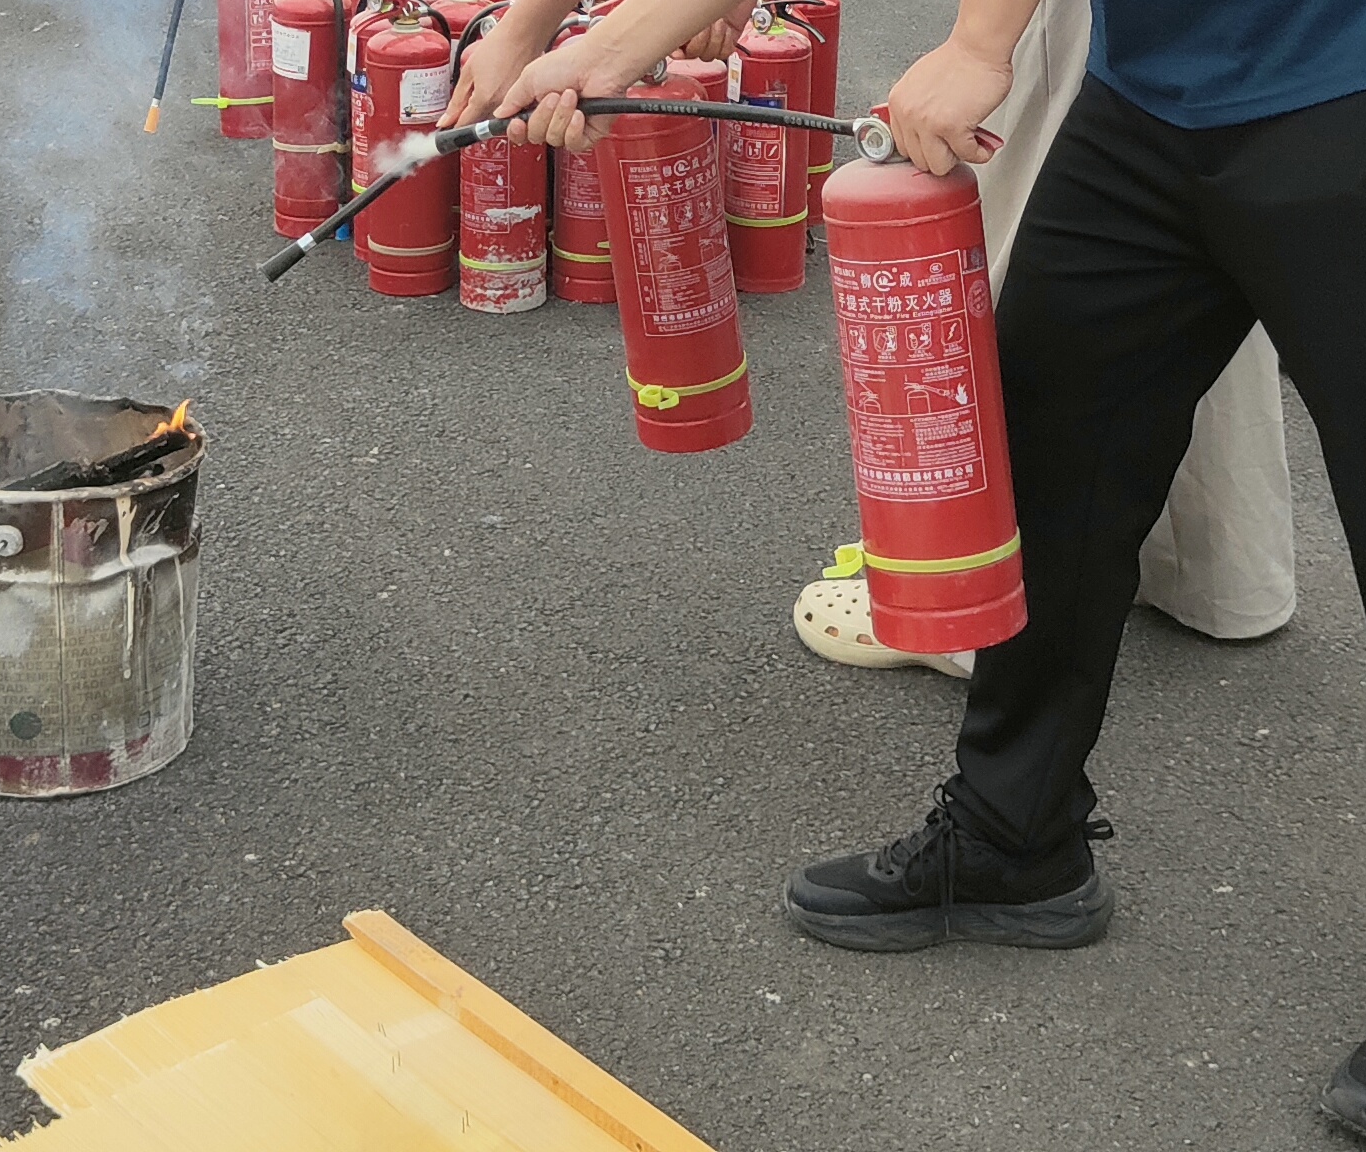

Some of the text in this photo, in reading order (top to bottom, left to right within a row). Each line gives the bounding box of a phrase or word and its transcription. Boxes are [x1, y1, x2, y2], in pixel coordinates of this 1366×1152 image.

[837, 288, 953, 314] 手提式干粉灭火器
